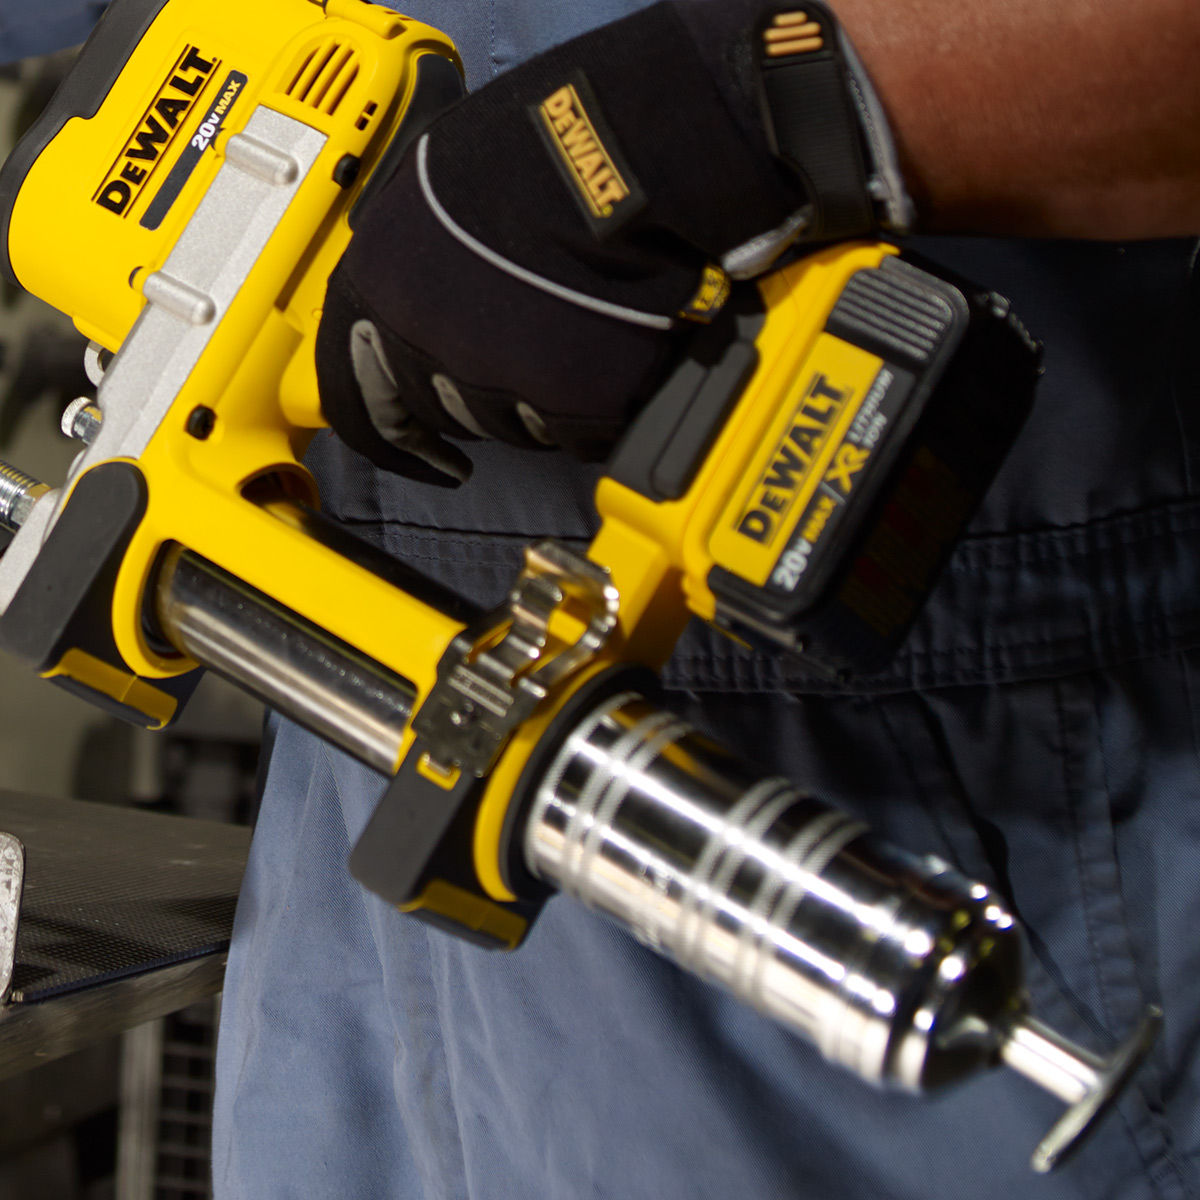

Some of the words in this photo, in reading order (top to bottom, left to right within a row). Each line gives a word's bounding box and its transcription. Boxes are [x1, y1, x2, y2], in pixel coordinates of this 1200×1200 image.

[96, 46, 214, 216] DEWALT
[214, 80, 241, 115] MAX
[543, 86, 624, 207] DEWALT
[847, 368, 894, 444] LITHIUM
[862, 411, 888, 449] ION
[737, 374, 844, 544] DEWALT
[825, 441, 871, 494] XR
